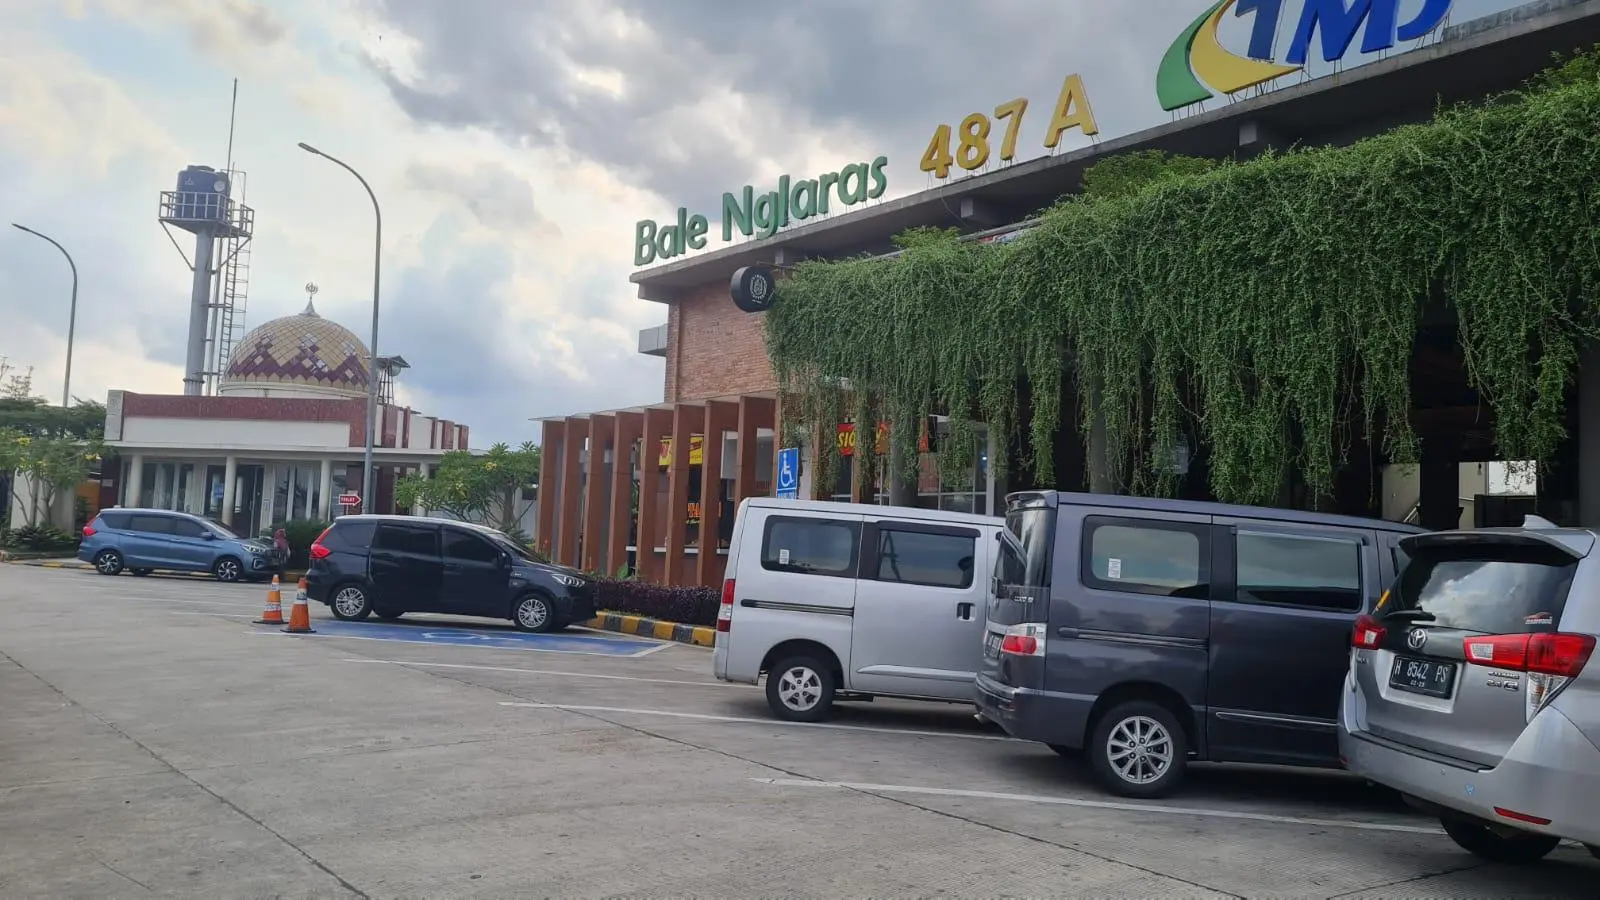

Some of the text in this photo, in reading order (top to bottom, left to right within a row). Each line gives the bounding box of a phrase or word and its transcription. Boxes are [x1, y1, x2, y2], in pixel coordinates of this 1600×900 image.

[919, 72, 1100, 179] 487 A
[634, 156, 888, 267] Bale Nglaras
[1394, 659, 1449, 683] H 8542 PS
